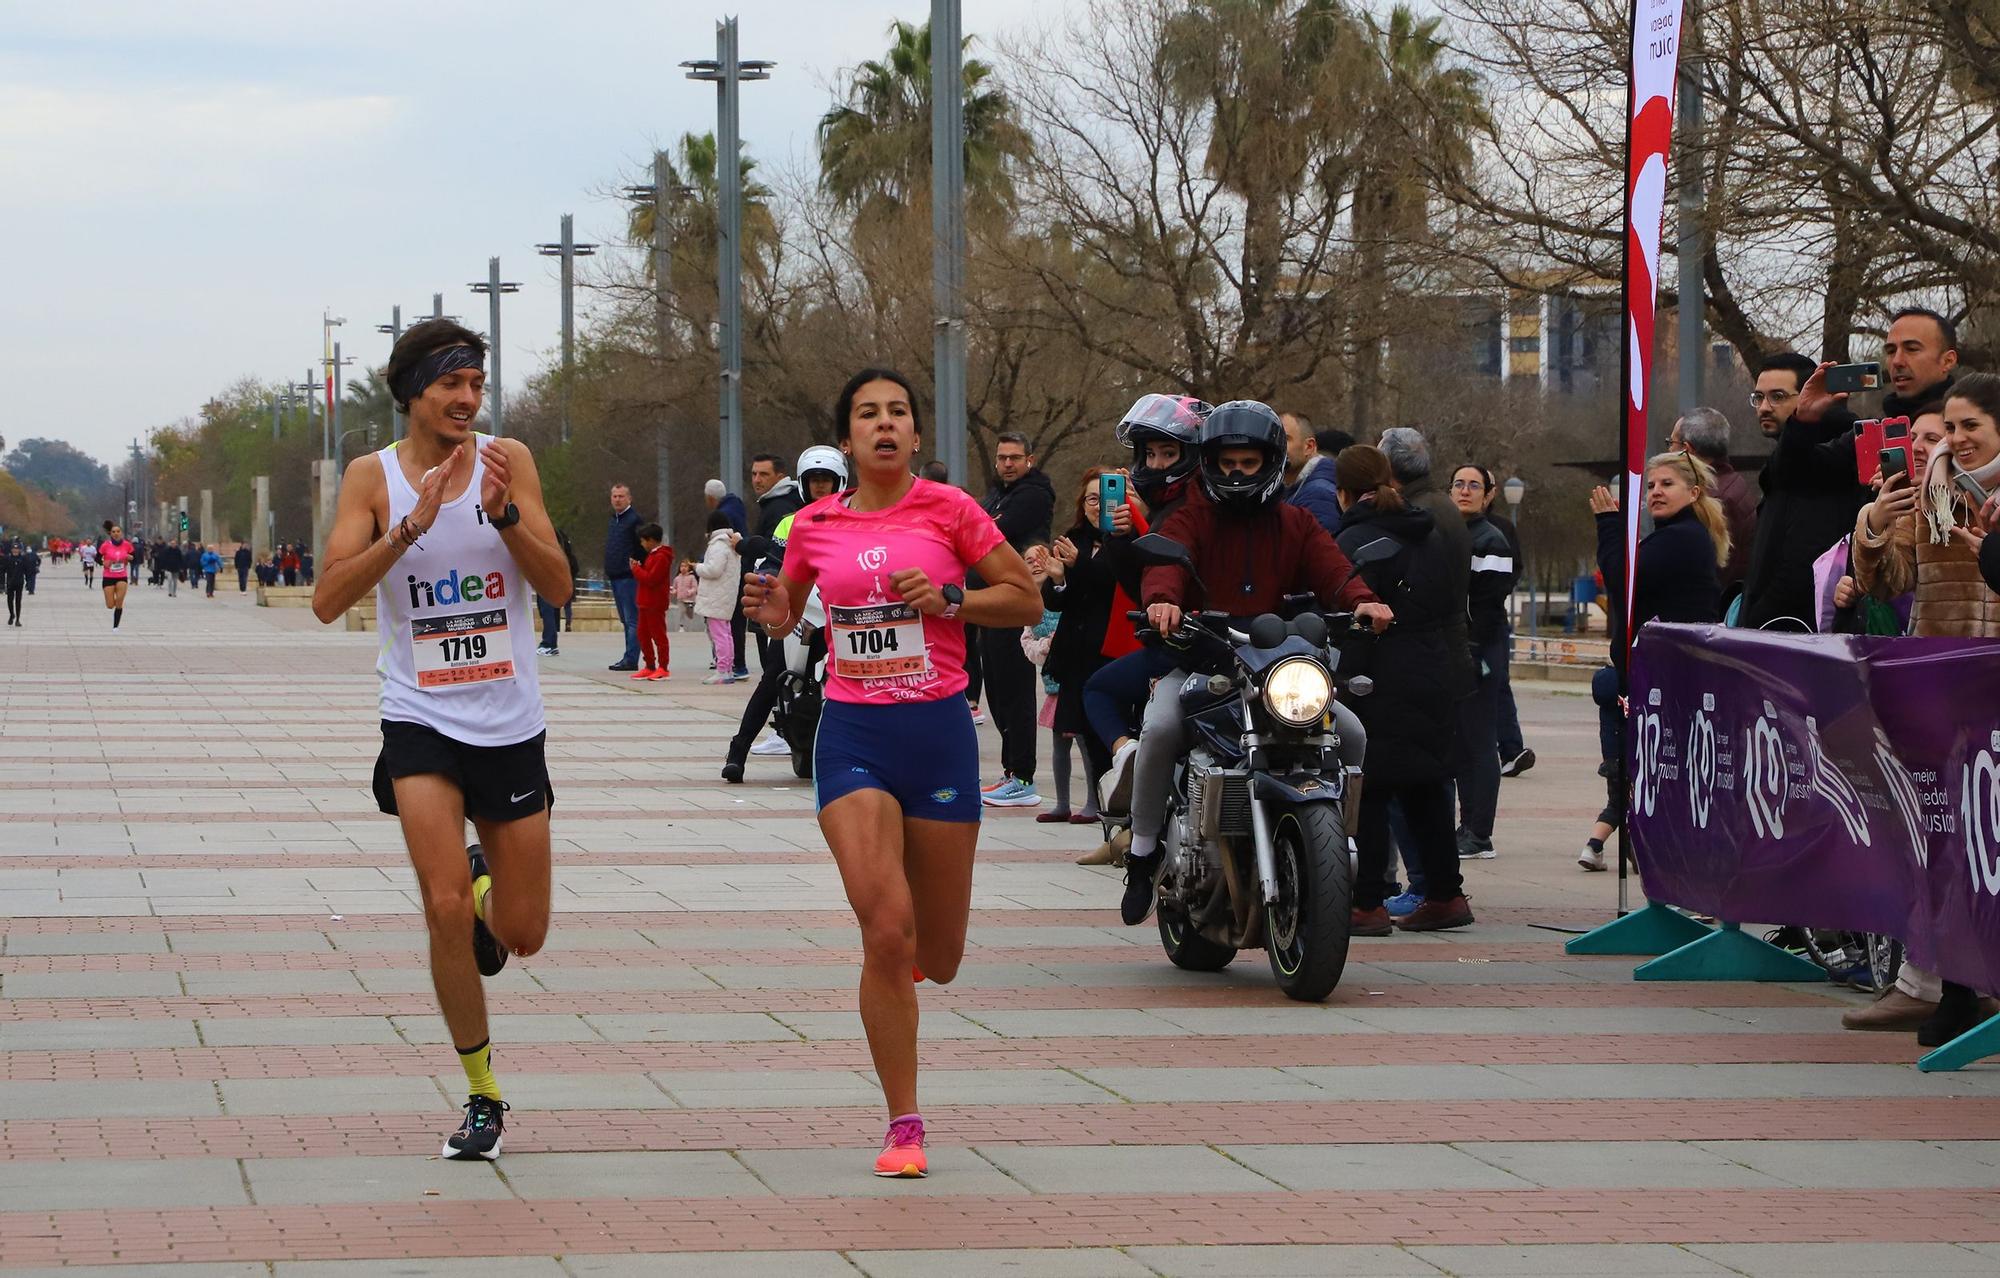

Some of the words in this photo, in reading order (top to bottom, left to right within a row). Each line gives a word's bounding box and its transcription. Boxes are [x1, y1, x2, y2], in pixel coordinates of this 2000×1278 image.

[407, 569, 505, 609] indea
[439, 634, 487, 662] 1719
[847, 628, 899, 655] 1704
[863, 670, 938, 690] RUNNING
[891, 690, 924, 700] 2023
